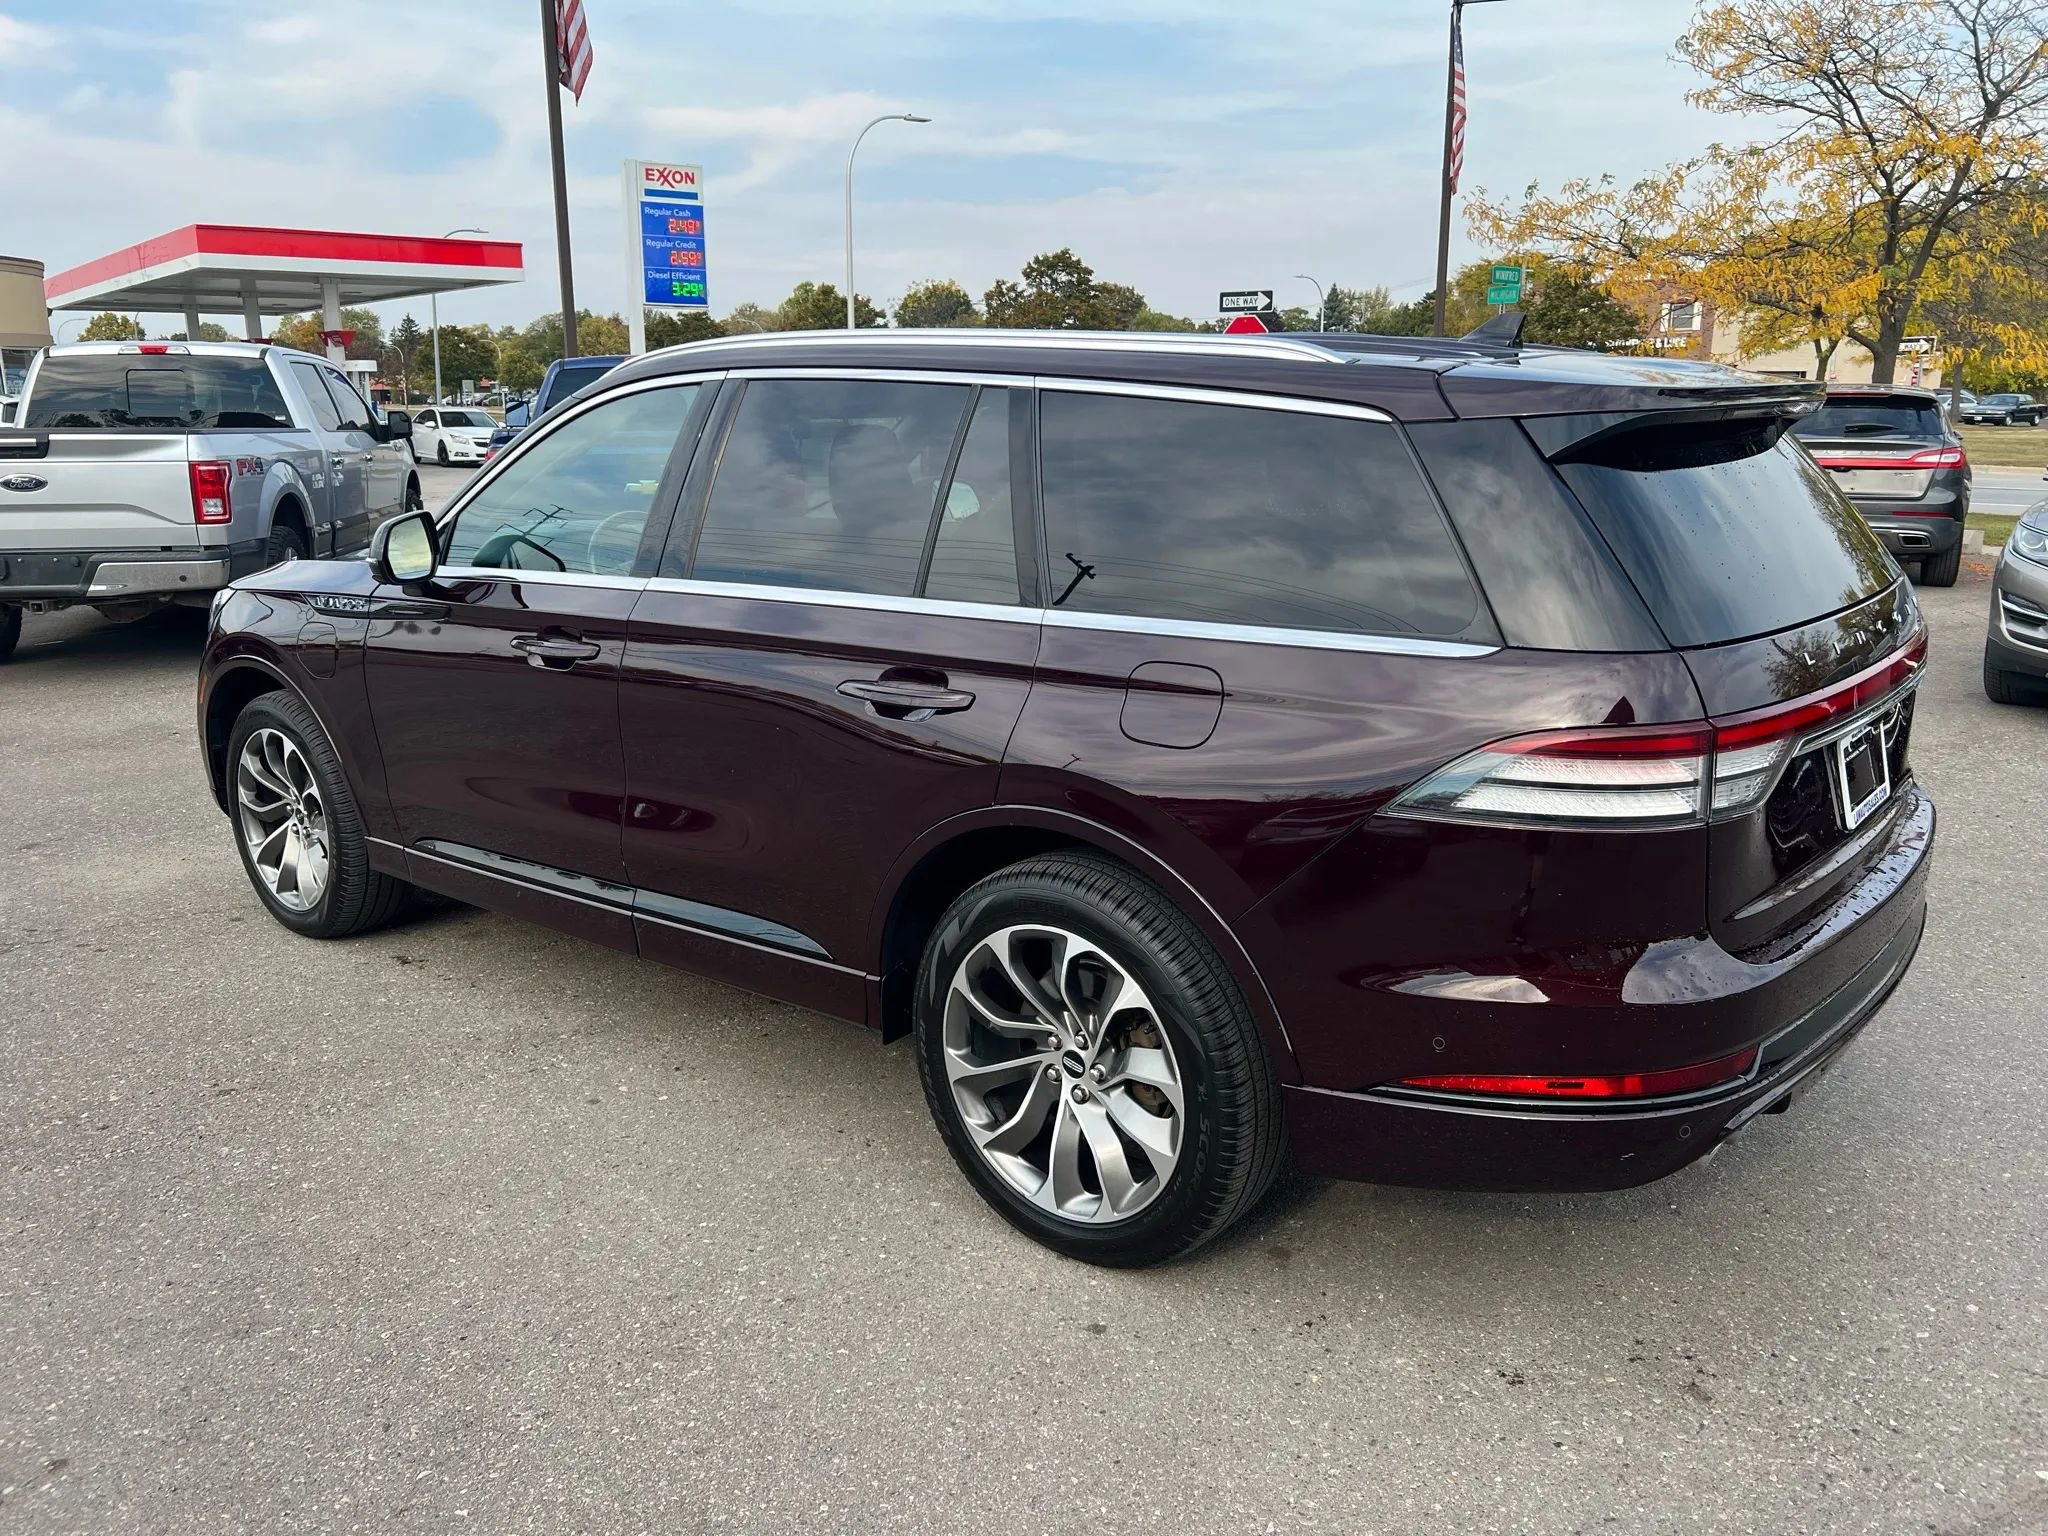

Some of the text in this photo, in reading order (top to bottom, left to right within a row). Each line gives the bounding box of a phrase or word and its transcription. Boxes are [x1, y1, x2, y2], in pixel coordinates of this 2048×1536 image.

[644, 167, 696, 189] EXXON
[644, 206, 691, 217] Regular Cash
[646, 239, 697, 249] Regular Credit
[647, 270, 701, 281] Diesel Efficient
[1224, 296, 1259, 307] ONE WAY
[236, 456, 264, 476] FX4
[9, 477, 36, 489] Ford
